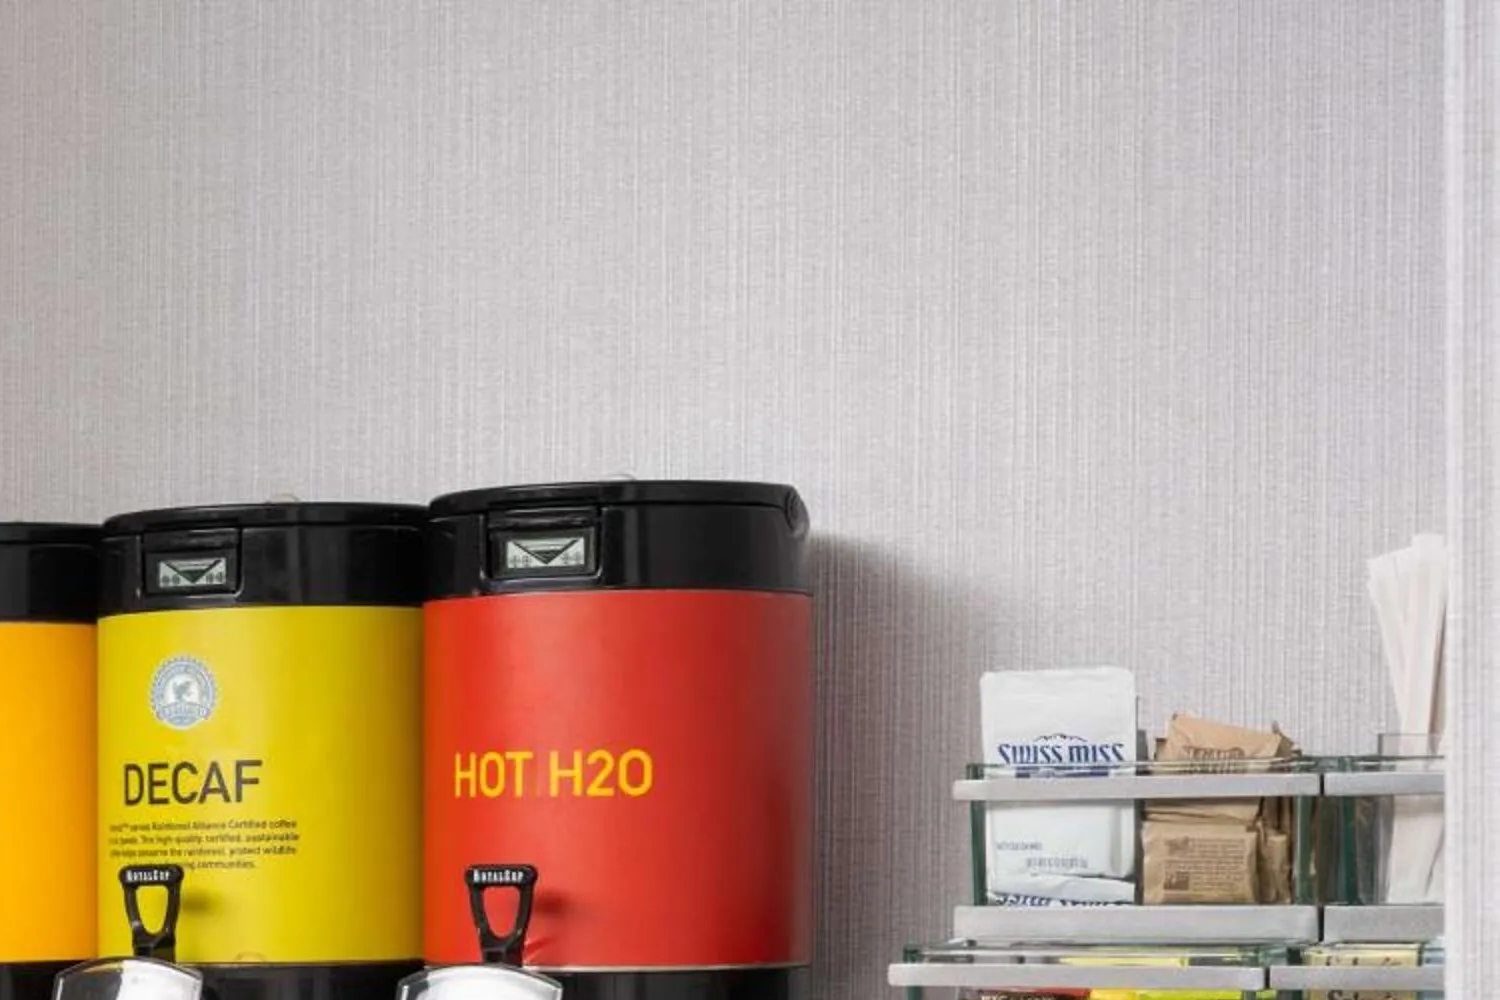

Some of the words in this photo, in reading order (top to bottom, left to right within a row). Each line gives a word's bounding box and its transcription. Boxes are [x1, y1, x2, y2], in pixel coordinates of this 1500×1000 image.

[123, 759, 263, 806] DECAF
[454, 750, 534, 799] HOT
[550, 748, 653, 798] H2O
